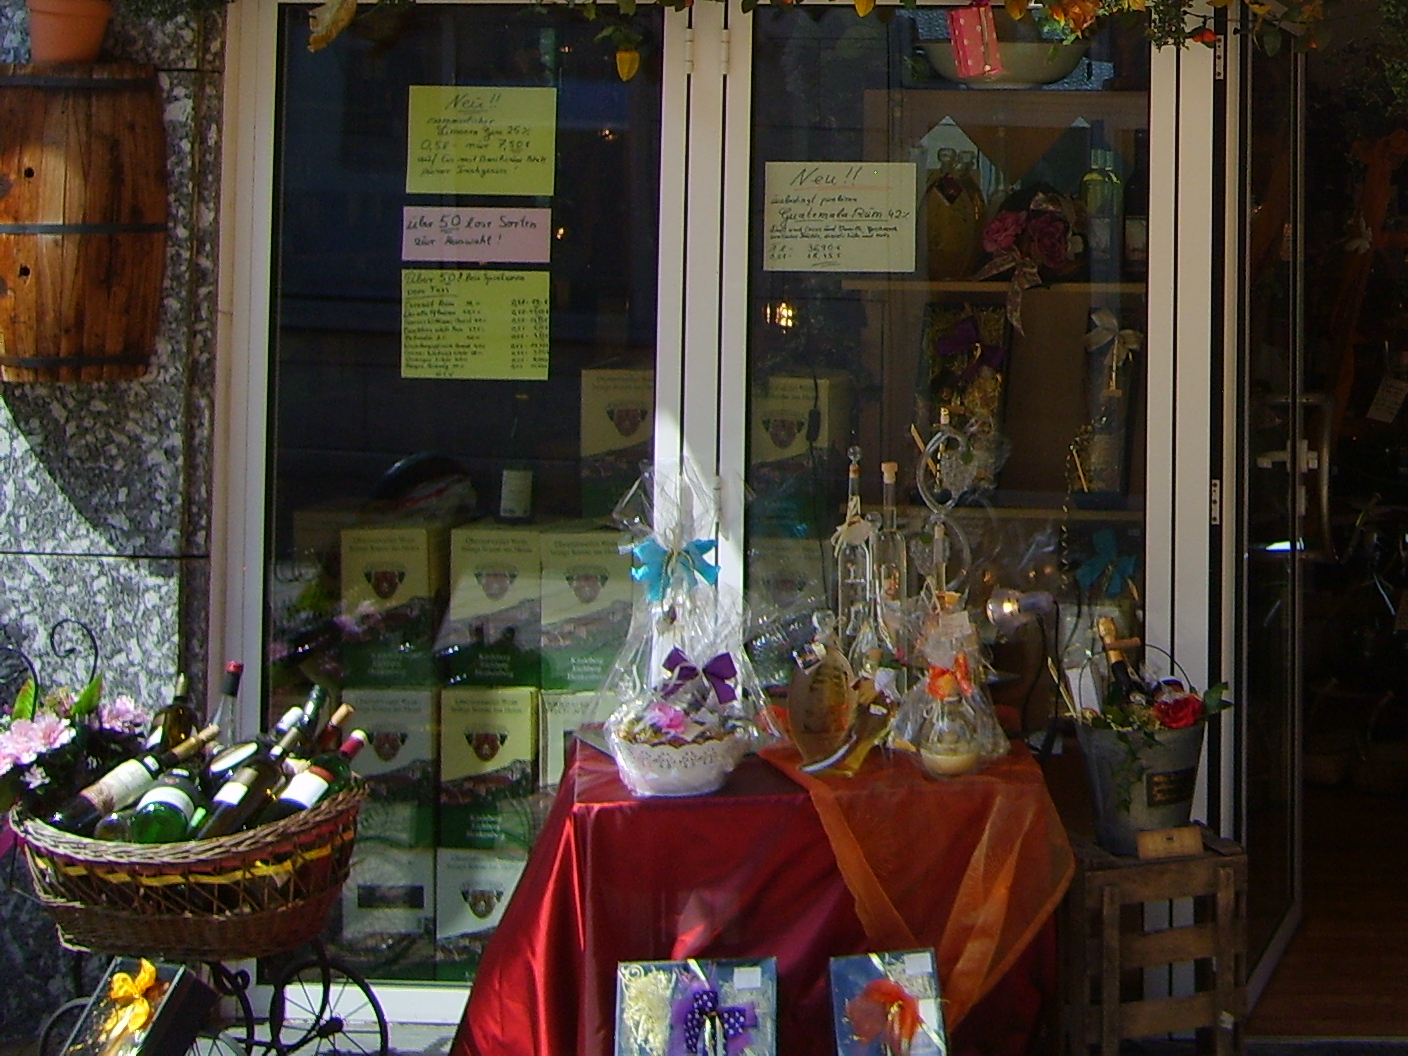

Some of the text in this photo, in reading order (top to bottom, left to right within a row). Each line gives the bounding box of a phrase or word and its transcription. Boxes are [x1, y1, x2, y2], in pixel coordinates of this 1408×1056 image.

[440, 214, 461, 229] 50
[464, 216, 492, 228] lose
[499, 215, 538, 229] Sorten
